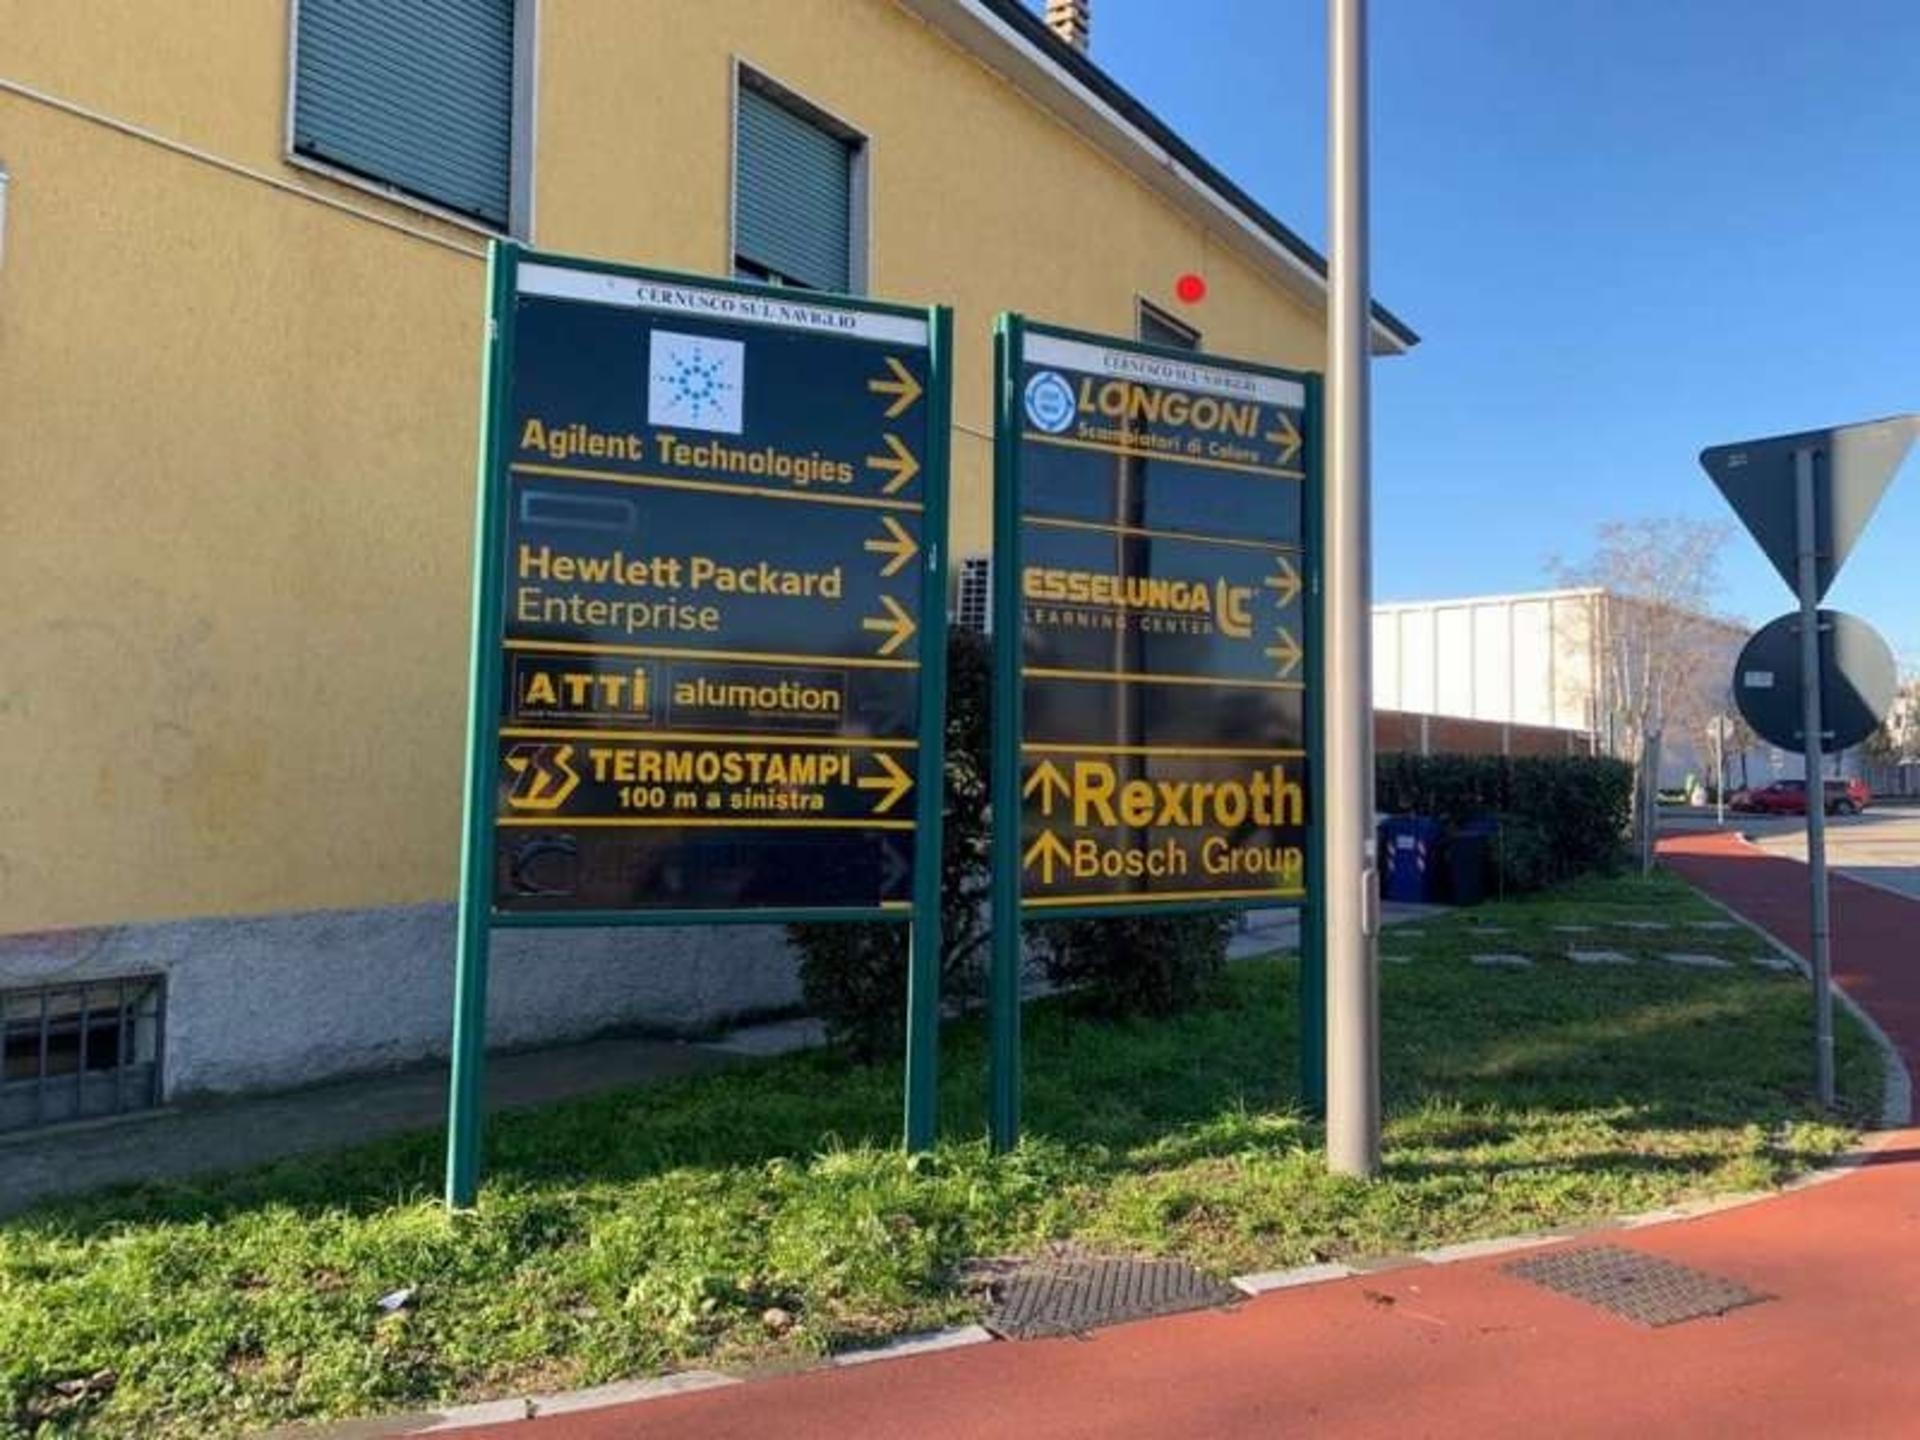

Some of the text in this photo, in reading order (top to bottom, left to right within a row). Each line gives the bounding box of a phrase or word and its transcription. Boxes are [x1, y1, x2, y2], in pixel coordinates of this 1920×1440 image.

[637, 286, 735, 312] CERNUSCO
[740, 301, 773, 319] SUL
[1079, 376, 1261, 438] LONGONI
[520, 418, 854, 485] Agilent Technologies
[518, 544, 842, 598] Hewlett Packard
[1022, 566, 1212, 612] ESSELUNGA
[517, 586, 720, 634] Enterprise
[1024, 608, 1127, 632] LEARNING
[674, 677, 842, 711] alumotion
[589, 747, 851, 786] TERMOSTAMPI
[618, 786, 824, 812] 100 m a sinistra
[1074, 759, 1302, 828] Rexroth
[1074, 836, 1303, 881] Bosch Group
